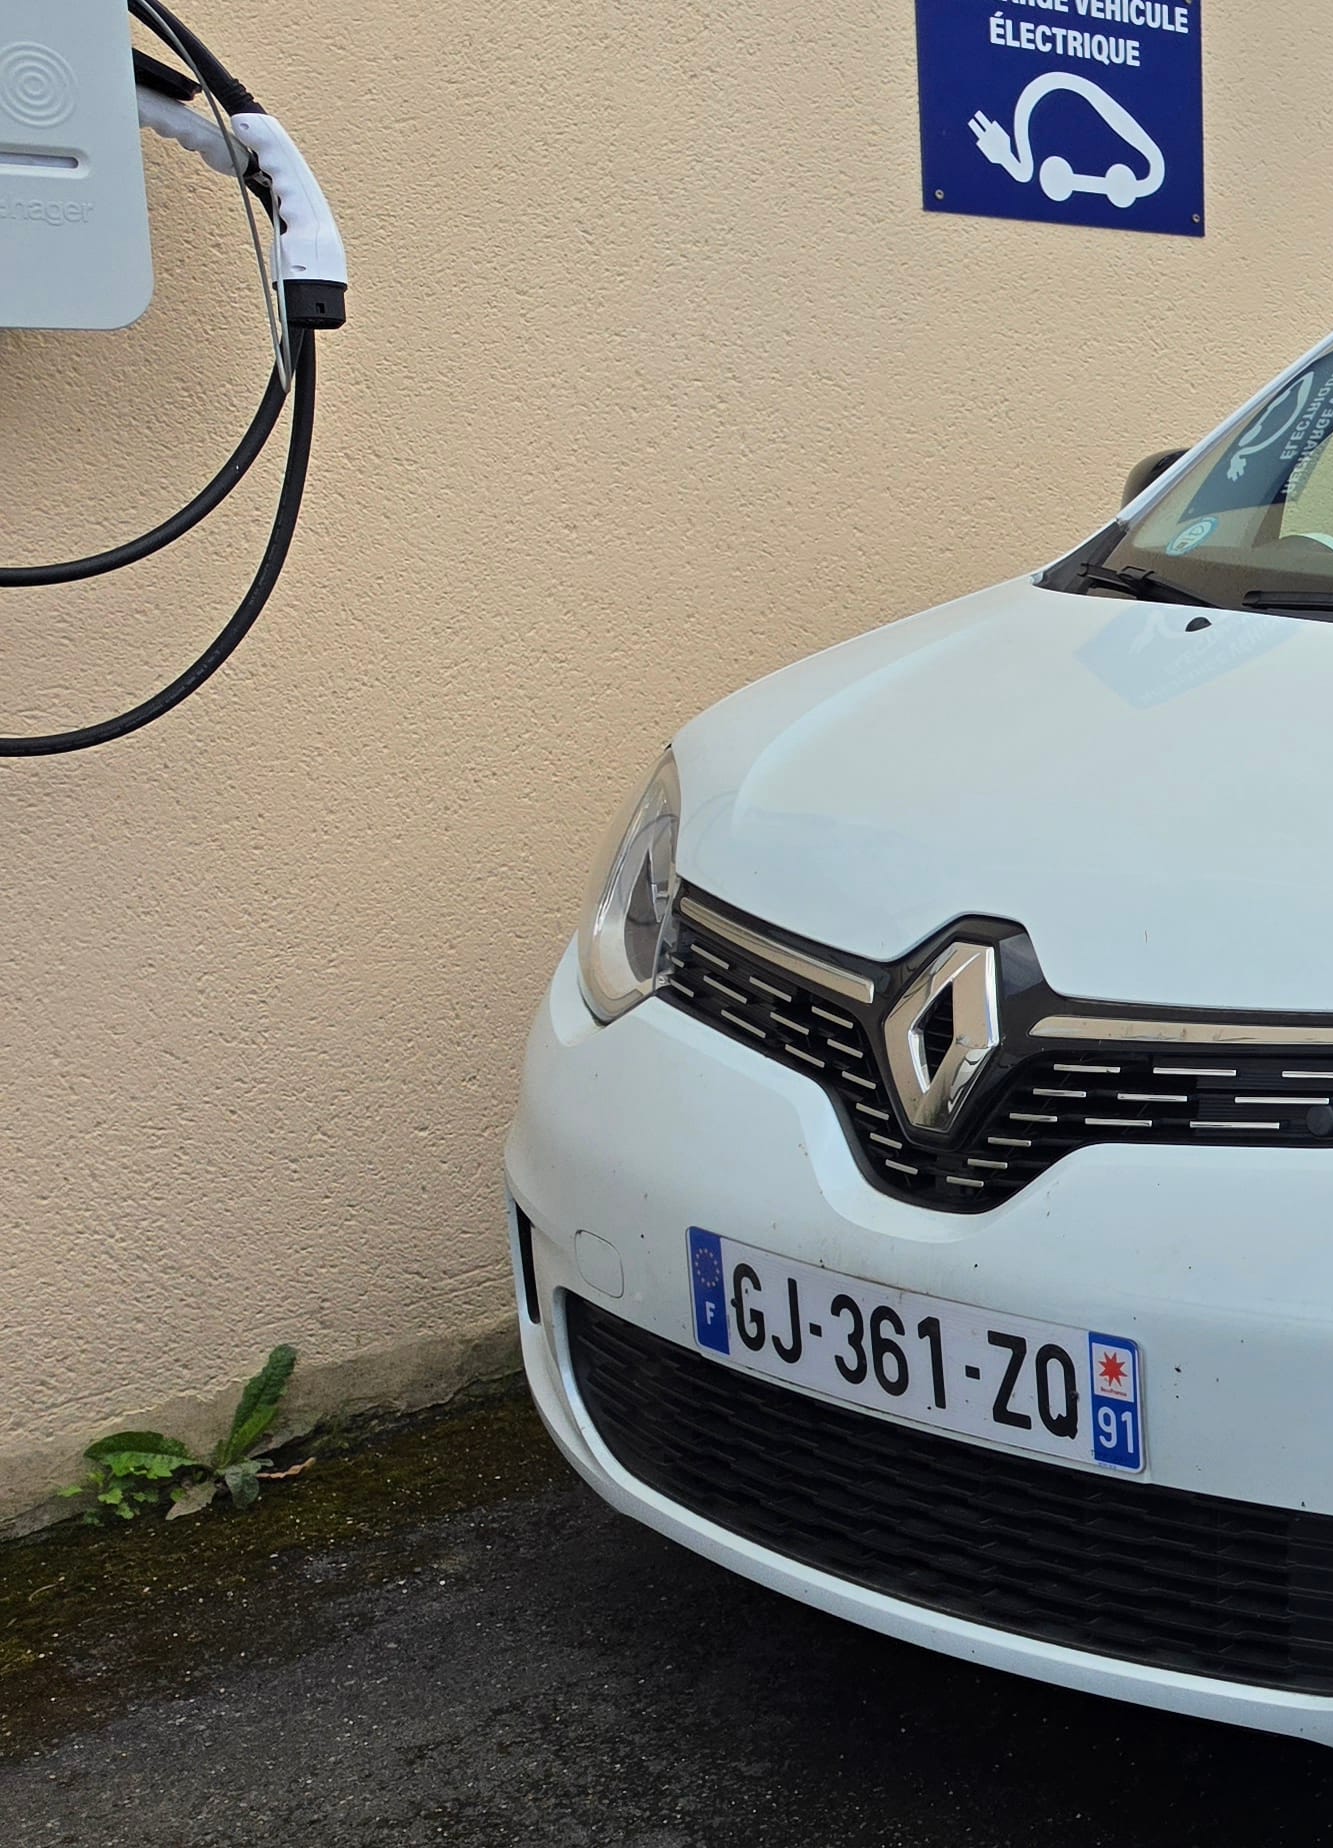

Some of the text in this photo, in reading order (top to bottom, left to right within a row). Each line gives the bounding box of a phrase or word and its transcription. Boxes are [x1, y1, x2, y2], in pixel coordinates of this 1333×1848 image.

[990, 11, 1140, 67] ÉLECTRIQUE
[705, 1300, 716, 1325] F
[732, 1262, 1079, 1439] GJ-361-ZQ
[1097, 1405, 1135, 1454] 91
